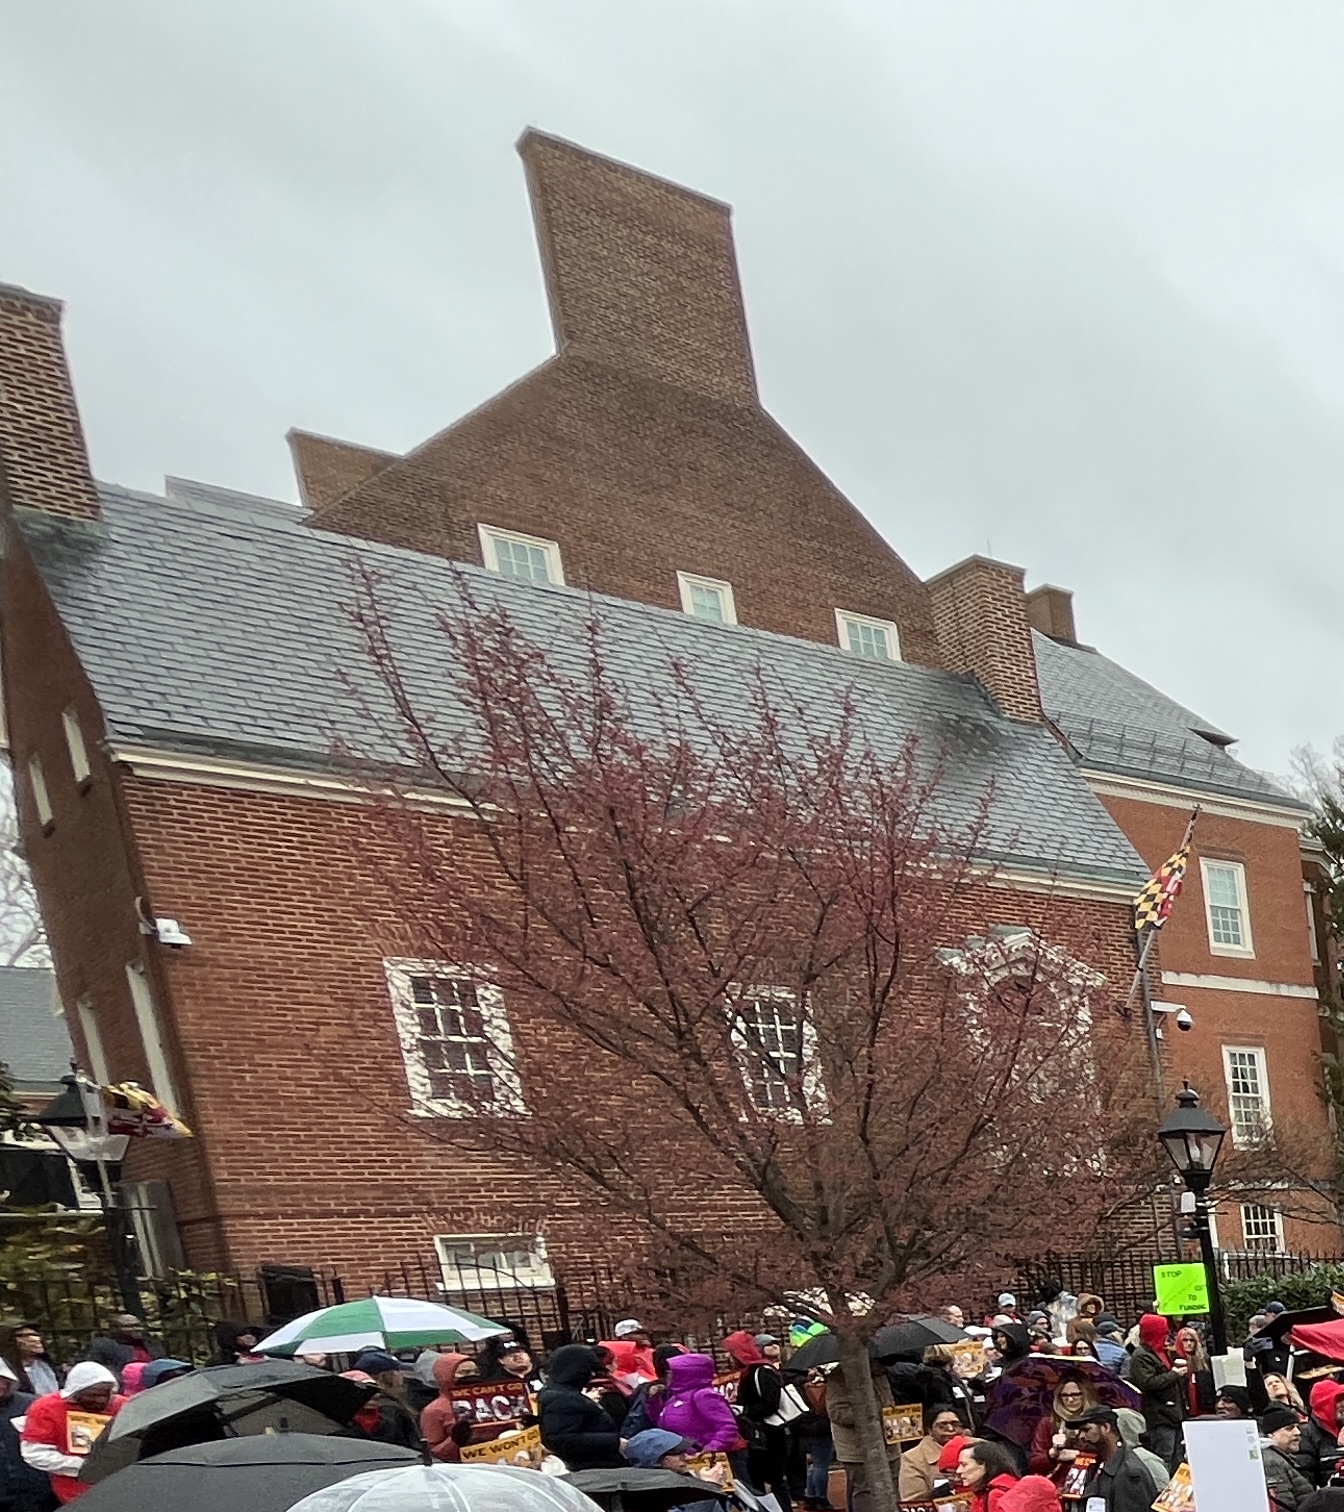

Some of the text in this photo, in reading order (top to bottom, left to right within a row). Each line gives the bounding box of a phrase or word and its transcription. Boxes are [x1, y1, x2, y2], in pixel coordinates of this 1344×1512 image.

[1161, 1270, 1182, 1278] STOP
[462, 1447, 486, 1460] WE
[489, 1435, 527, 1454] WON'T
